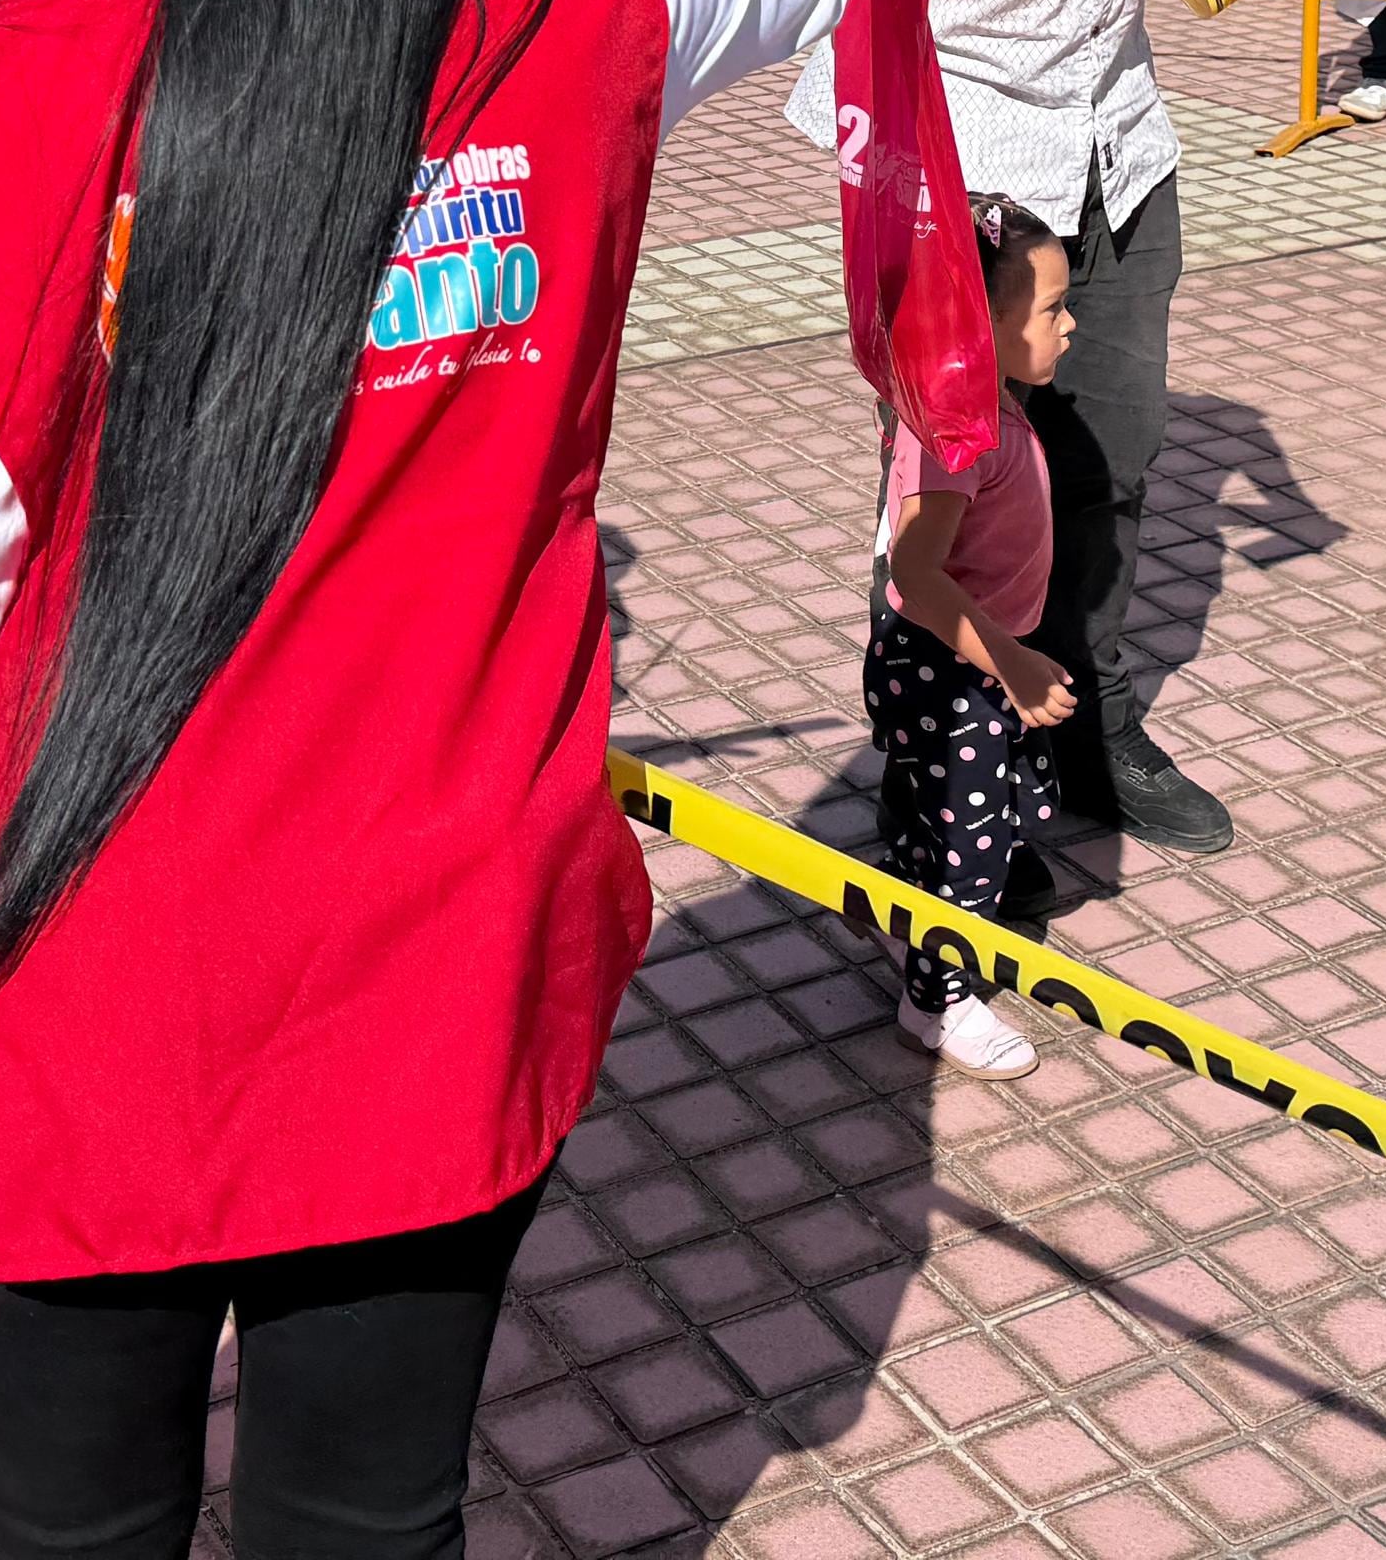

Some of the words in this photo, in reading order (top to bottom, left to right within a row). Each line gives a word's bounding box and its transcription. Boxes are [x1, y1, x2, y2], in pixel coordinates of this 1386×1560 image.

[454, 143, 531, 184] obras
[373, 345, 433, 391] cuida
[438, 355, 460, 376] tu
